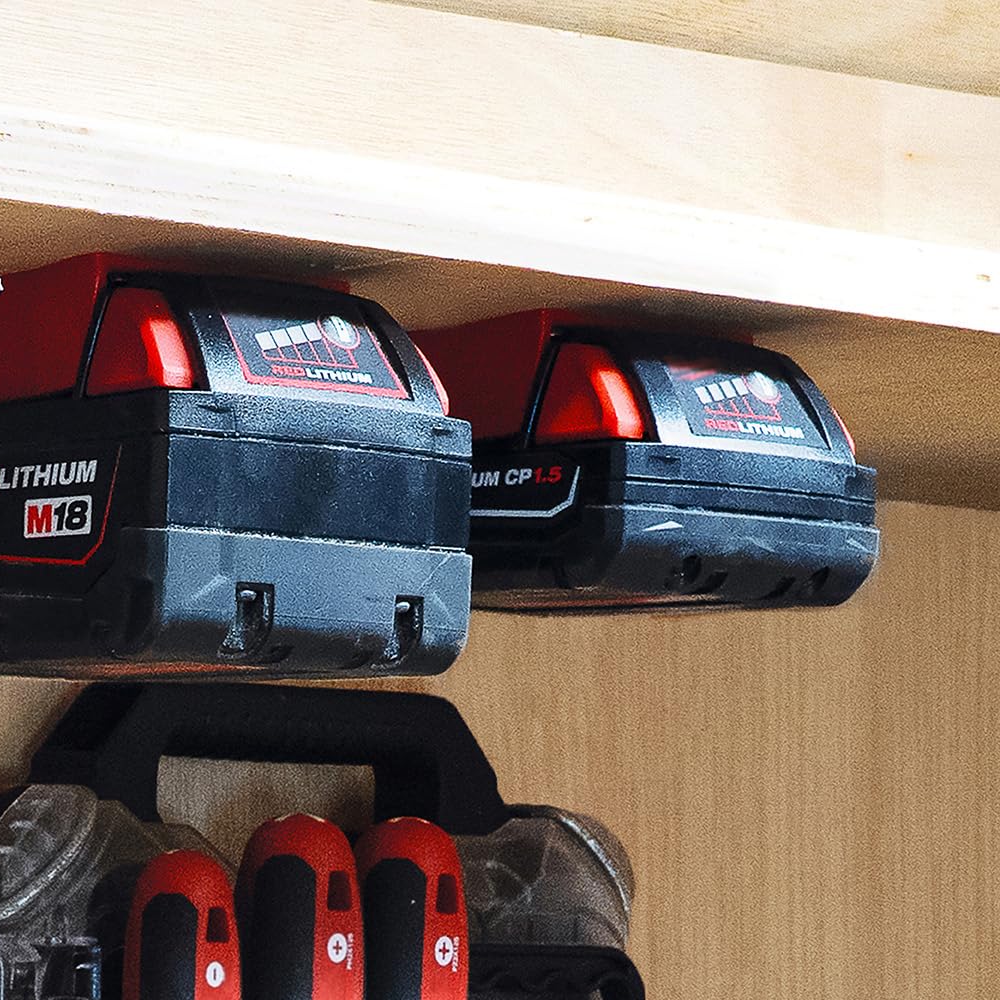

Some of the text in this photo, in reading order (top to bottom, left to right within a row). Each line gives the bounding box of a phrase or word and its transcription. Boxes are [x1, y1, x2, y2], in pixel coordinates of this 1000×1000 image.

[271, 364, 373, 384] REDLITHIUM
[704, 419, 805, 439] REDLITHIUM
[27, 500, 89, 535] M18
